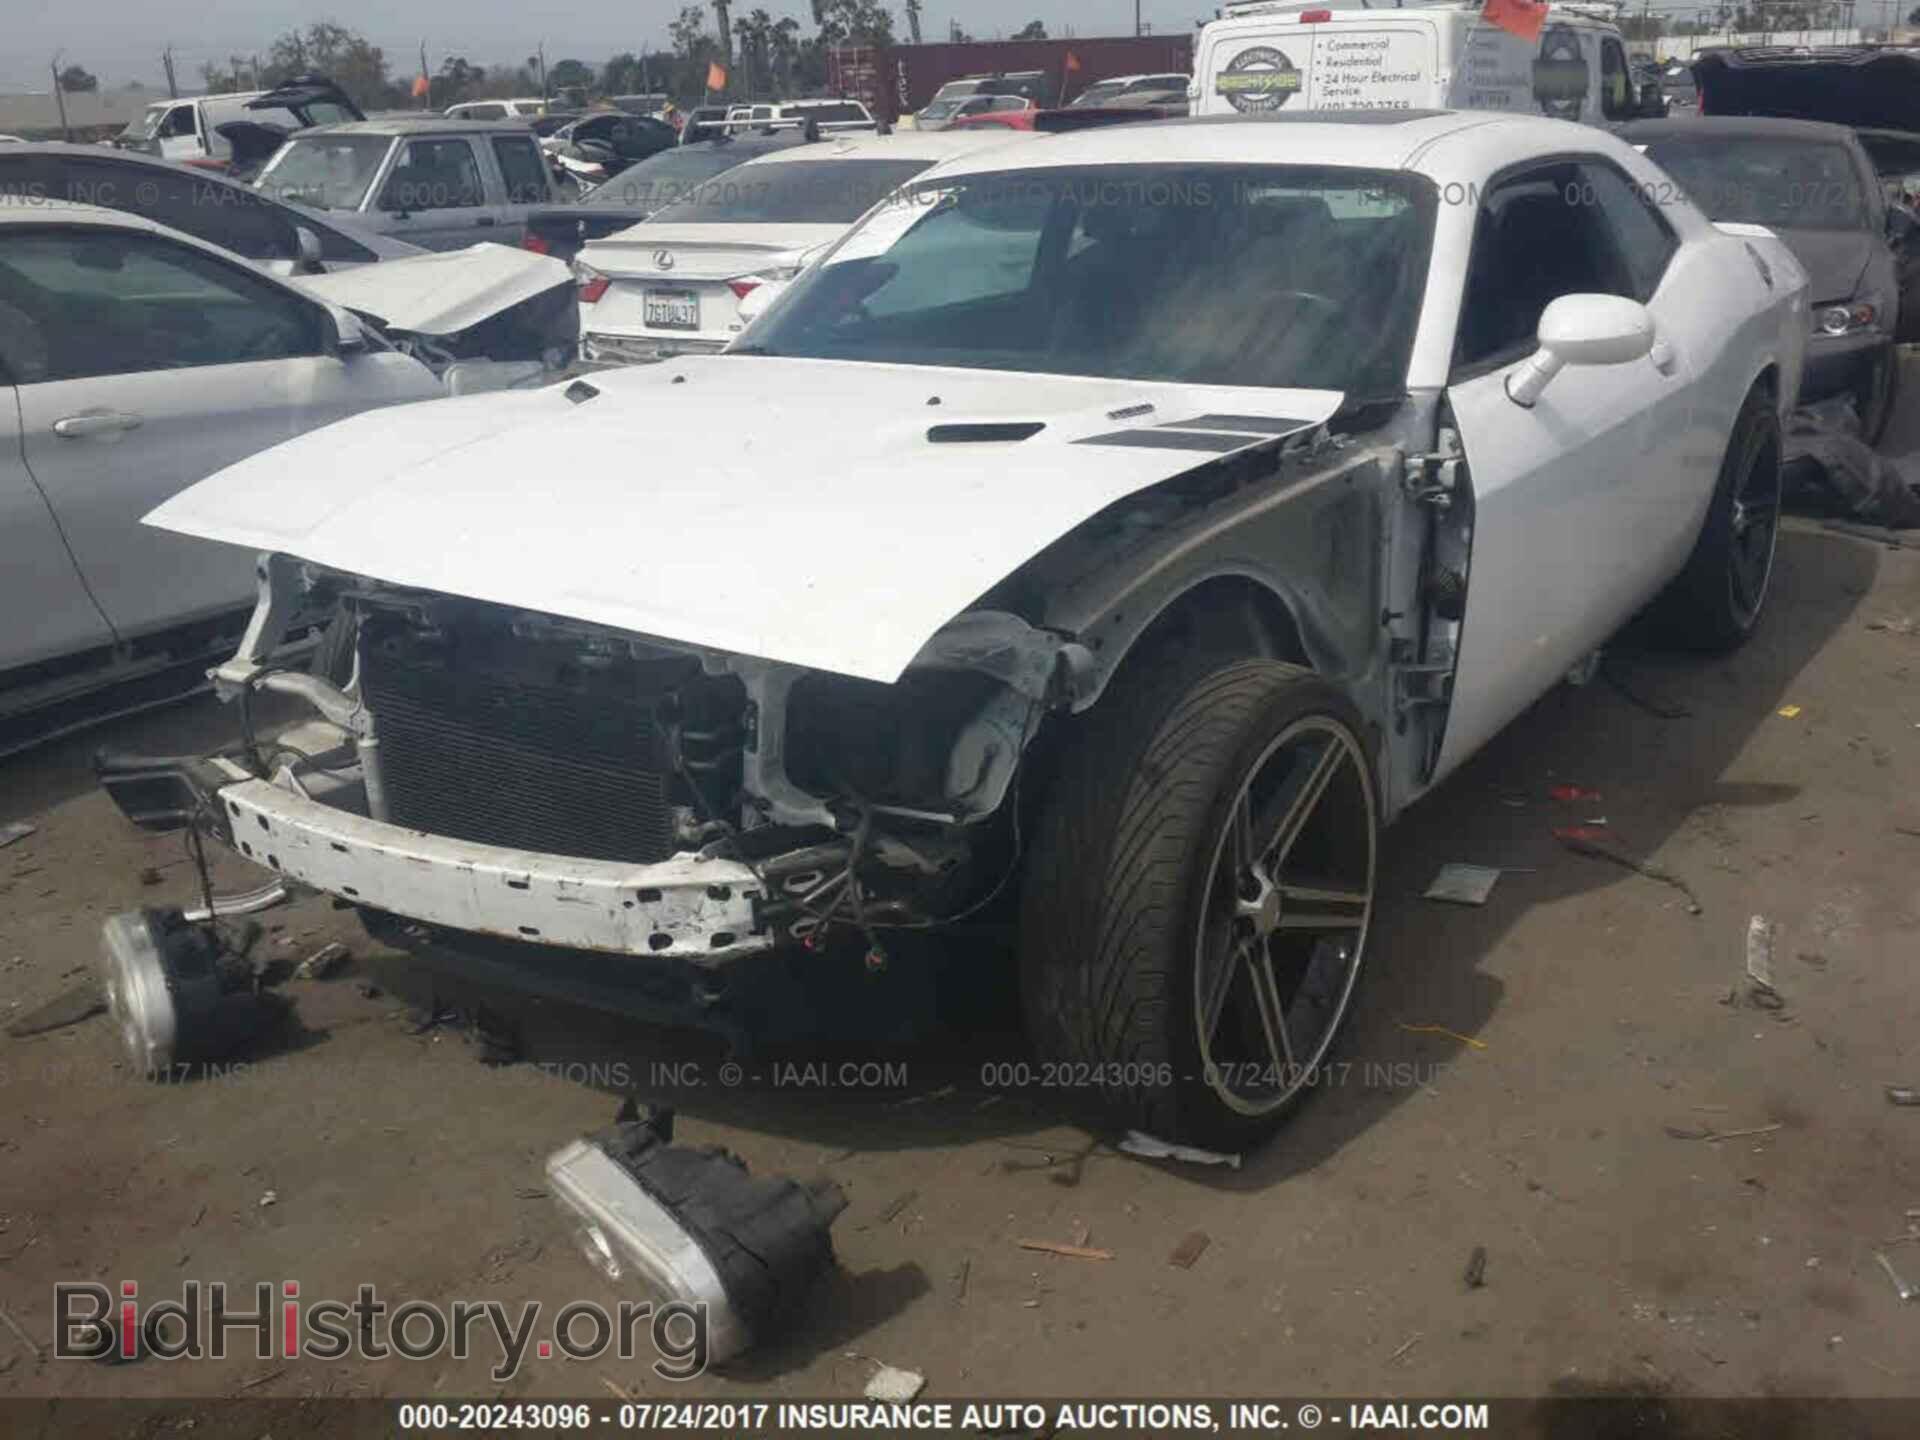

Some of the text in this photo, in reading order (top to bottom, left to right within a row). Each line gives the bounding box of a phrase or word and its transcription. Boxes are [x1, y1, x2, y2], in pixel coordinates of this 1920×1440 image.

[1327, 37, 1390, 51] Commercial
[1326, 55, 1382, 67] Residential
[1342, 73, 1369, 84] Hour
[1371, 71, 1421, 83] Electrical
[1322, 86, 1361, 97] Service
